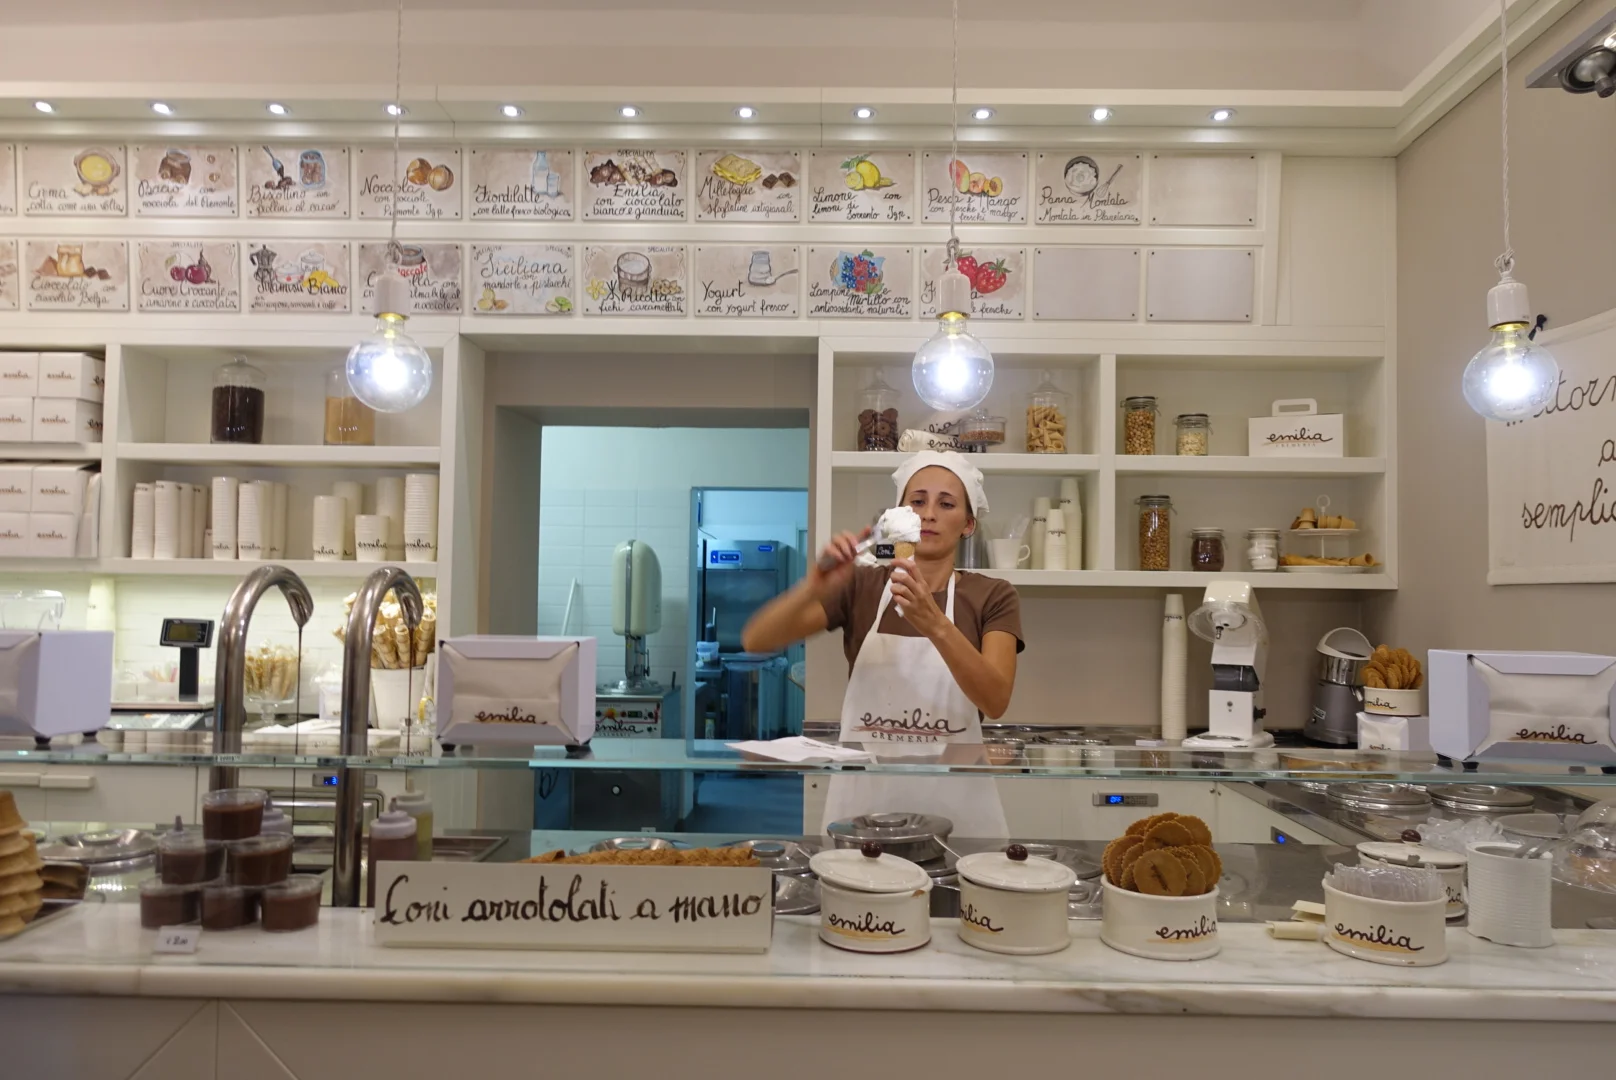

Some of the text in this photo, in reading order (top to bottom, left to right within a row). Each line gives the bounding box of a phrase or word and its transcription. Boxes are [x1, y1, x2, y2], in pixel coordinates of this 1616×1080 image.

[474, 184, 543, 203] Fiordilatte
[614, 184, 662, 198] Emilia
[813, 186, 858, 202] Limone
[1040, 186, 1128, 209] Panna Montata
[595, 192, 684, 208] con cioccolato
[813, 203, 843, 214] limoni
[950, 204, 976, 212] esche
[384, 204, 420, 216] Pimonte
[492, 204, 510, 215] latte
[593, 206, 626, 216] bianco
[1042, 207, 1079, 222] Montata
[481, 253, 567, 278] Siciliana
[308, 278, 347, 295] Bianco
[702, 280, 746, 305] Yogurt
[810, 282, 850, 301] Lampone
[726, 300, 756, 316] yogurt
[760, 299, 789, 315] fresco
[1266, 427, 1333, 442] emilia
[358, 538, 388, 548] emilia
[406, 538, 434, 548] milia
[1364, 698, 1397, 709] milia
[475, 706, 548, 725] emilia
[860, 708, 966, 734] emilia
[1516, 724, 1597, 744] emilia
[380, 874, 767, 924] Coni arrotolati a mano
[829, 912, 906, 935] emilia
[960, 904, 1004, 932] ilia
[1156, 915, 1217, 940] emilia
[1334, 922, 1424, 951] emilia
